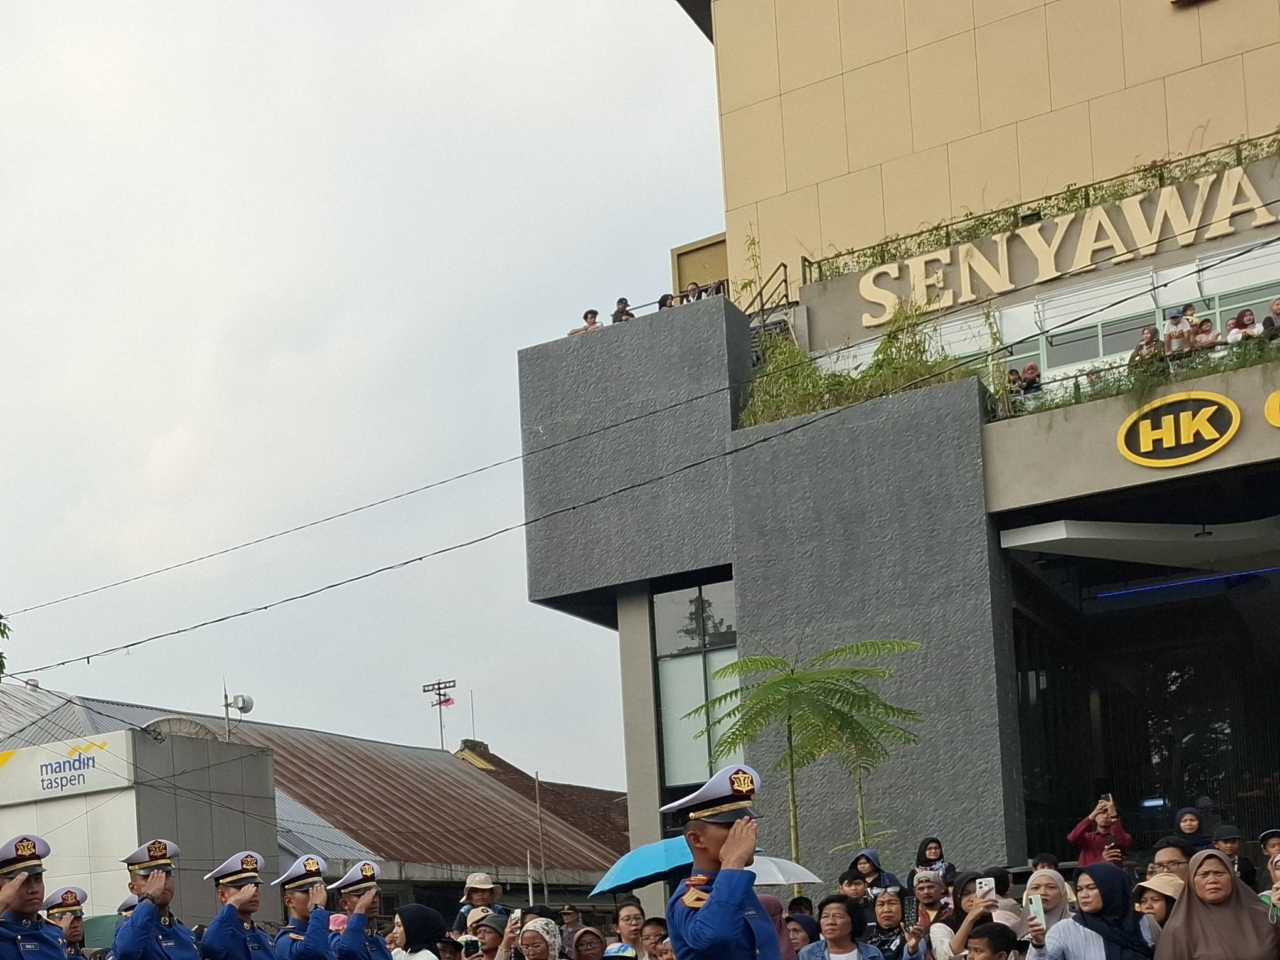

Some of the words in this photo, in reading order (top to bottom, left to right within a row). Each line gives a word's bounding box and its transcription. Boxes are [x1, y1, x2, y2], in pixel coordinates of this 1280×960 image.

[1138, 405, 1222, 453] HK
[40, 752, 96, 777] mandiri
[40, 773, 86, 792] taspen
